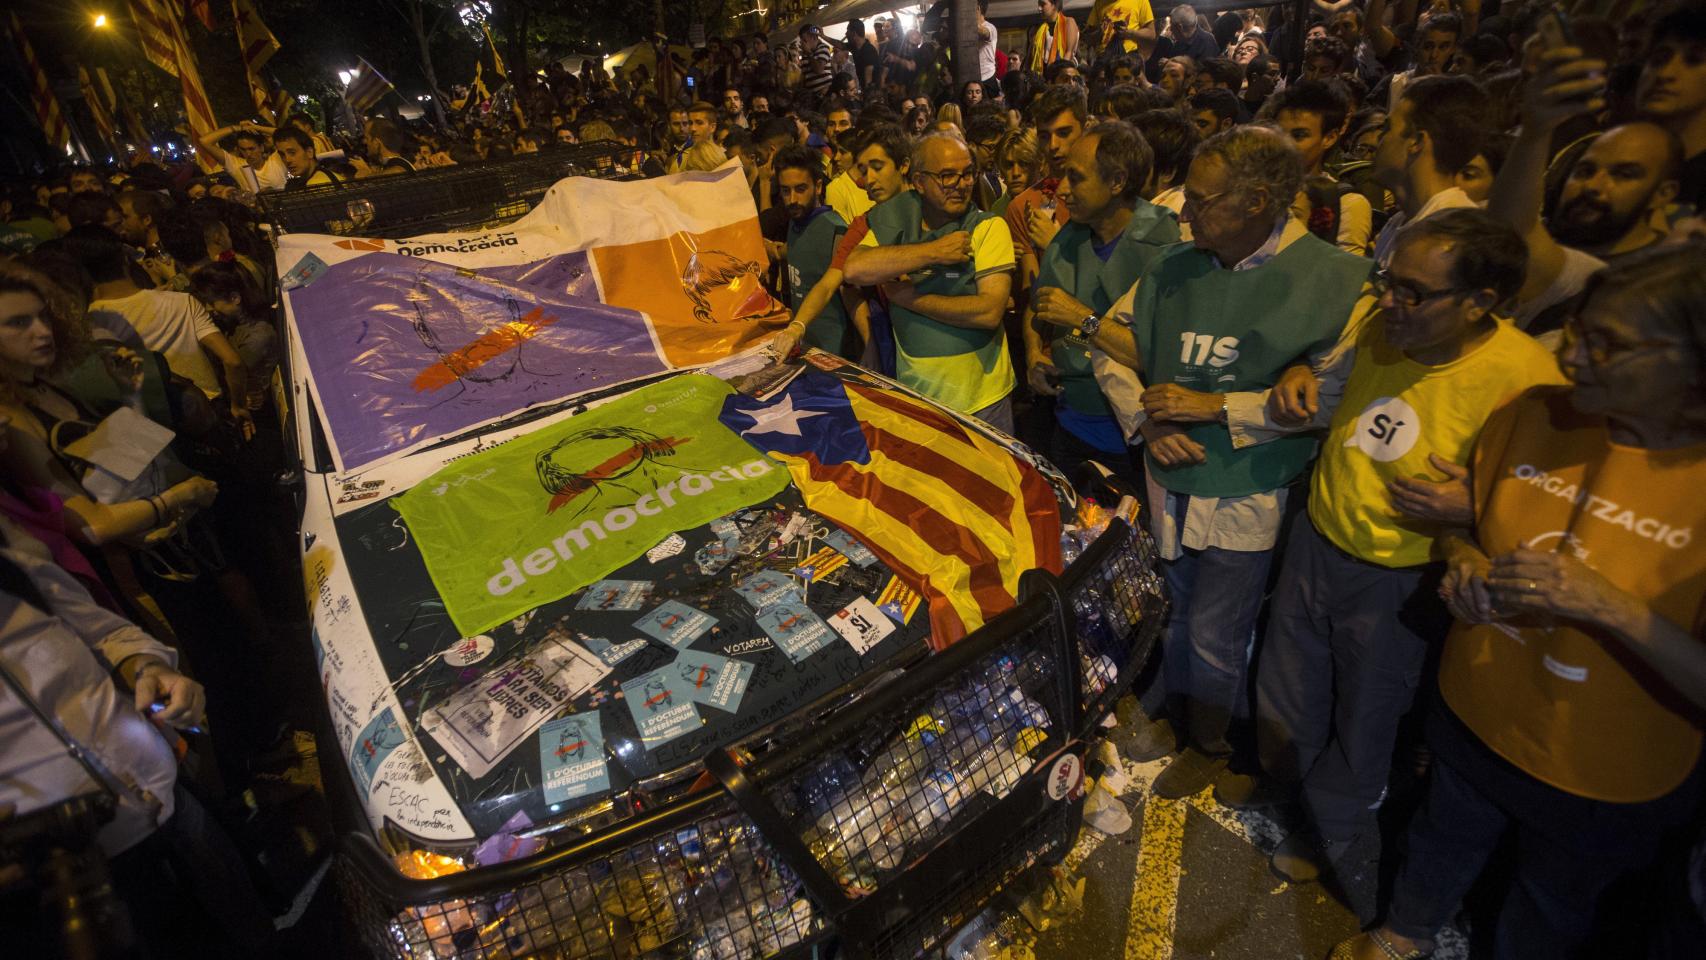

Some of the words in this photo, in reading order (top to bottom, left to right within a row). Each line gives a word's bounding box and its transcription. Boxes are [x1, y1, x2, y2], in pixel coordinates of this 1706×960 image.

[397, 236, 518, 257] Democràcia
[1180, 331, 1240, 368] 11S
[1368, 412, 1405, 445] Sí
[486, 459, 775, 596] democràcia
[486, 687, 529, 720] LIBRES
[524, 692, 553, 715] SER
